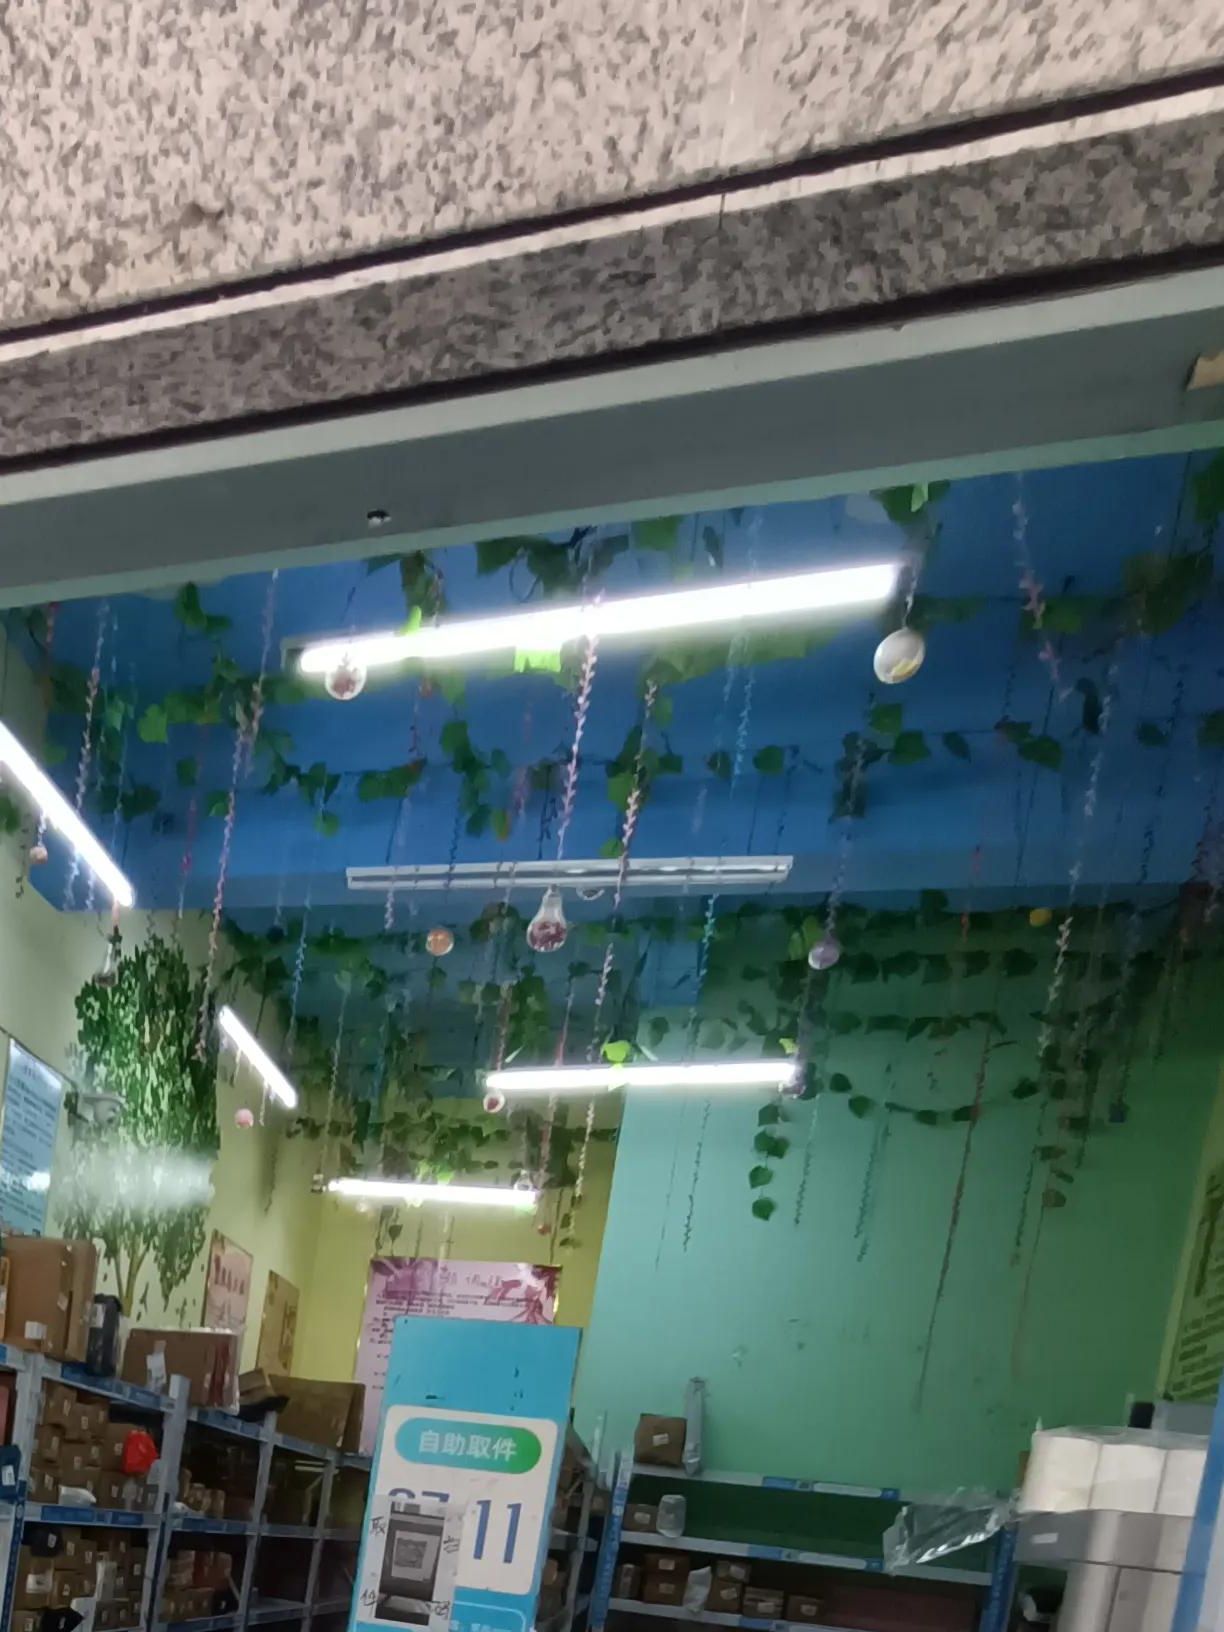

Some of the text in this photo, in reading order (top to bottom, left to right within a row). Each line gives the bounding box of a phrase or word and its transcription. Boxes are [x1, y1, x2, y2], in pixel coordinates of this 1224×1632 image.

[418, 1429, 518, 1462] 自助取件
[473, 1499, 522, 1564] 11
